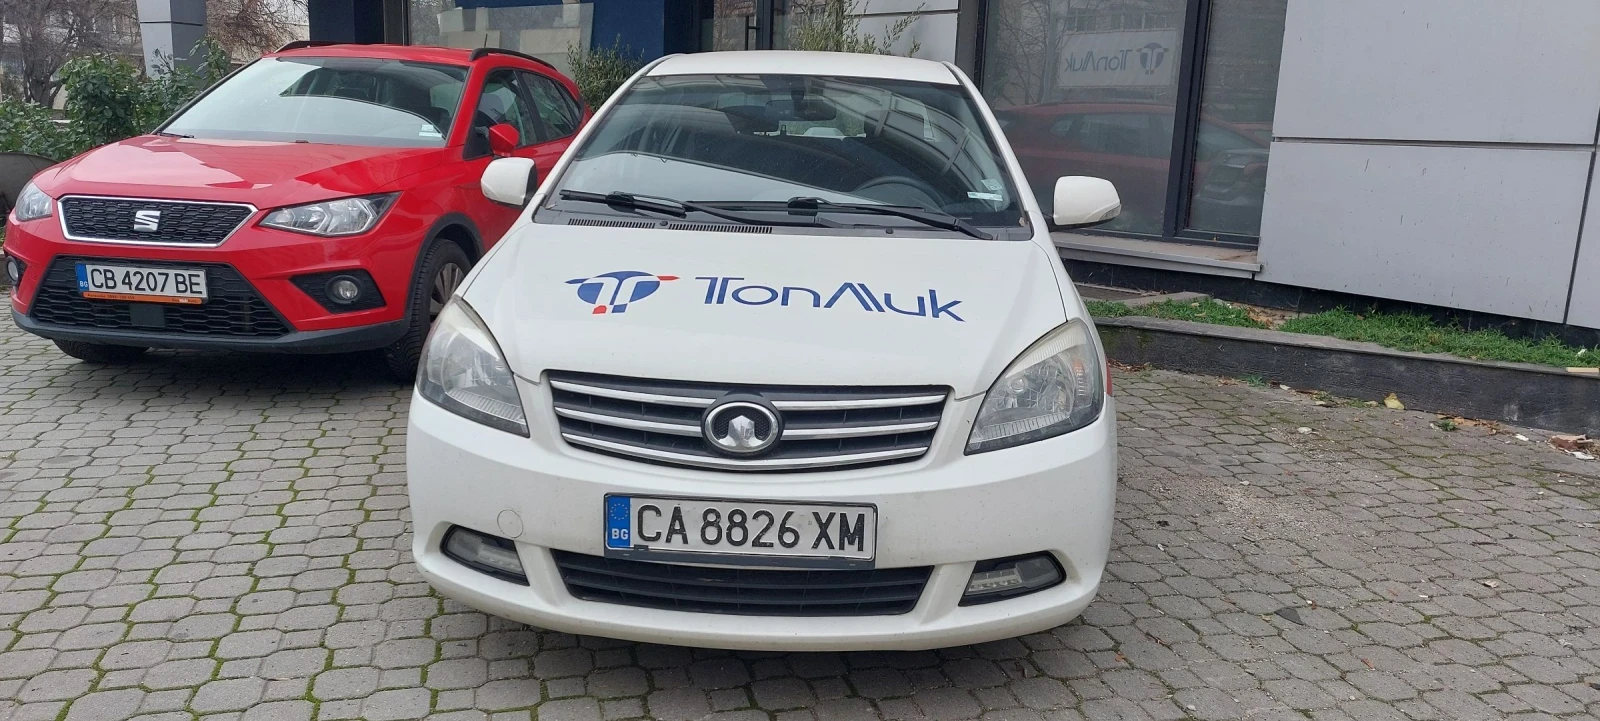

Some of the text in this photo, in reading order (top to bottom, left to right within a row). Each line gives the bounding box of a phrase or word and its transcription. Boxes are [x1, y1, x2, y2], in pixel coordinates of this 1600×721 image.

[79, 280, 89, 288] BG
[90, 268, 203, 294] CB 4207 BE
[611, 528, 629, 540] BG
[637, 503, 866, 552] CA 8826 XM
